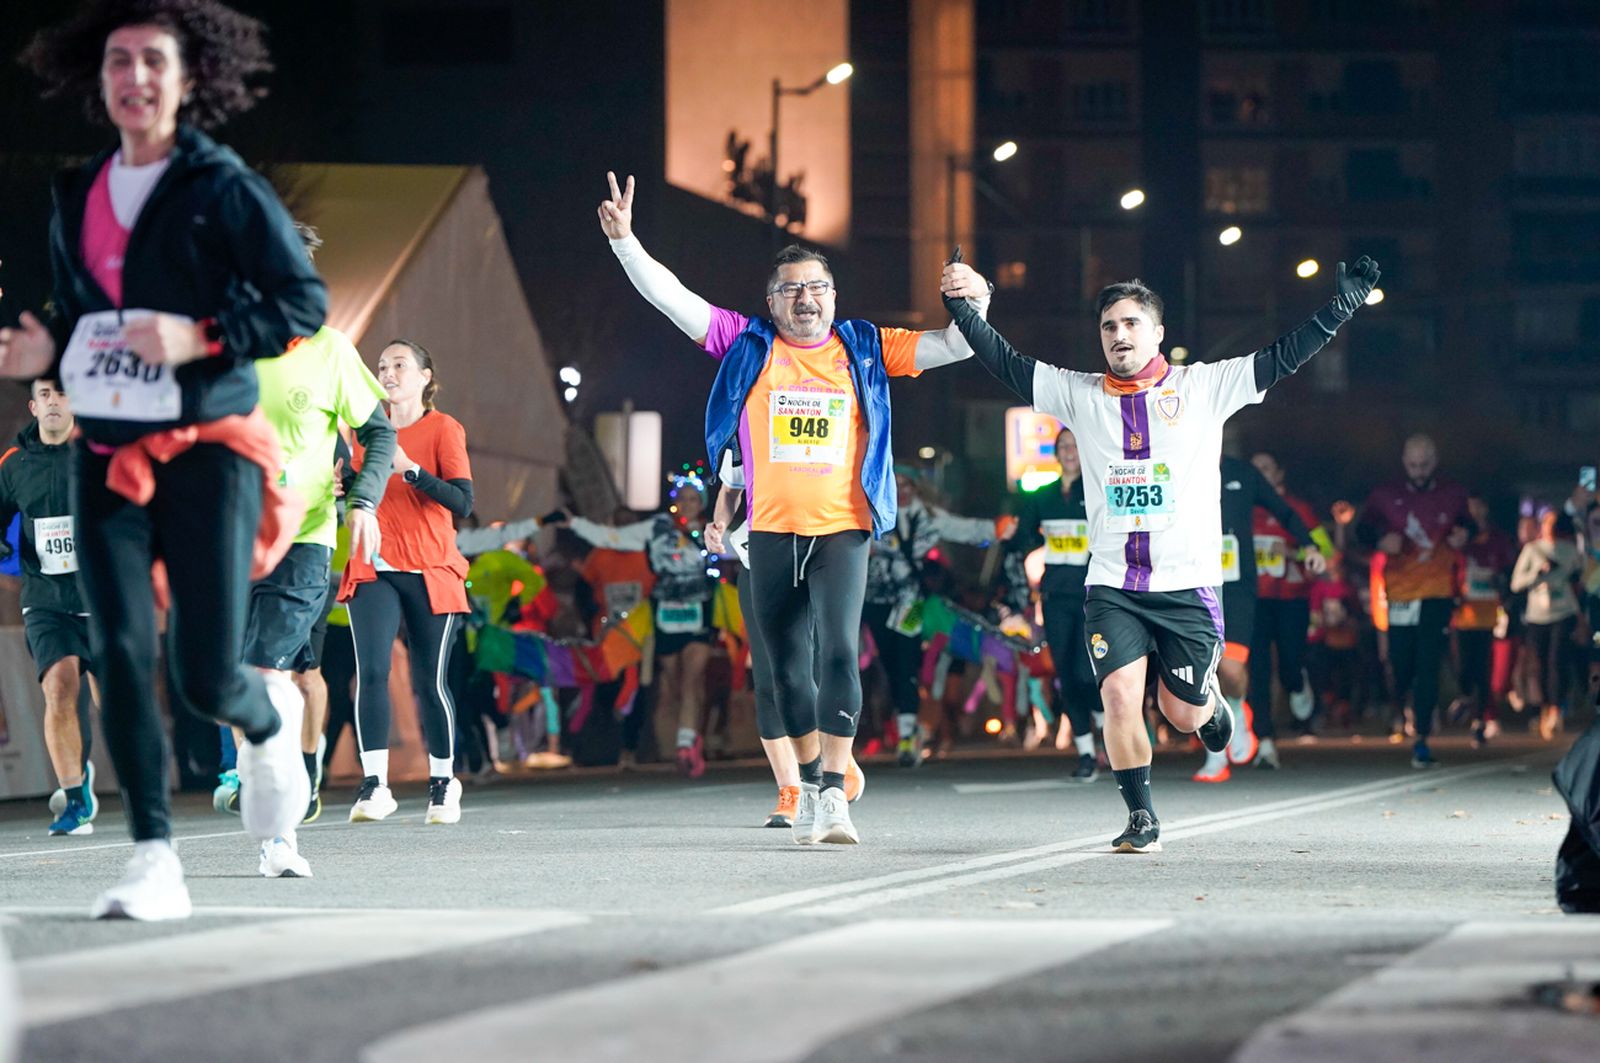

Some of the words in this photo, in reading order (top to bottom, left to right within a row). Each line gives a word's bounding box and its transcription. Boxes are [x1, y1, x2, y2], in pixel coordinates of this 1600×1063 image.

[787, 399, 811, 407] NOCHE
[778, 407, 794, 415] SAN
[789, 416, 829, 438] 948
[1108, 477, 1121, 485] SAN
[1114, 484, 1163, 508] 3253
